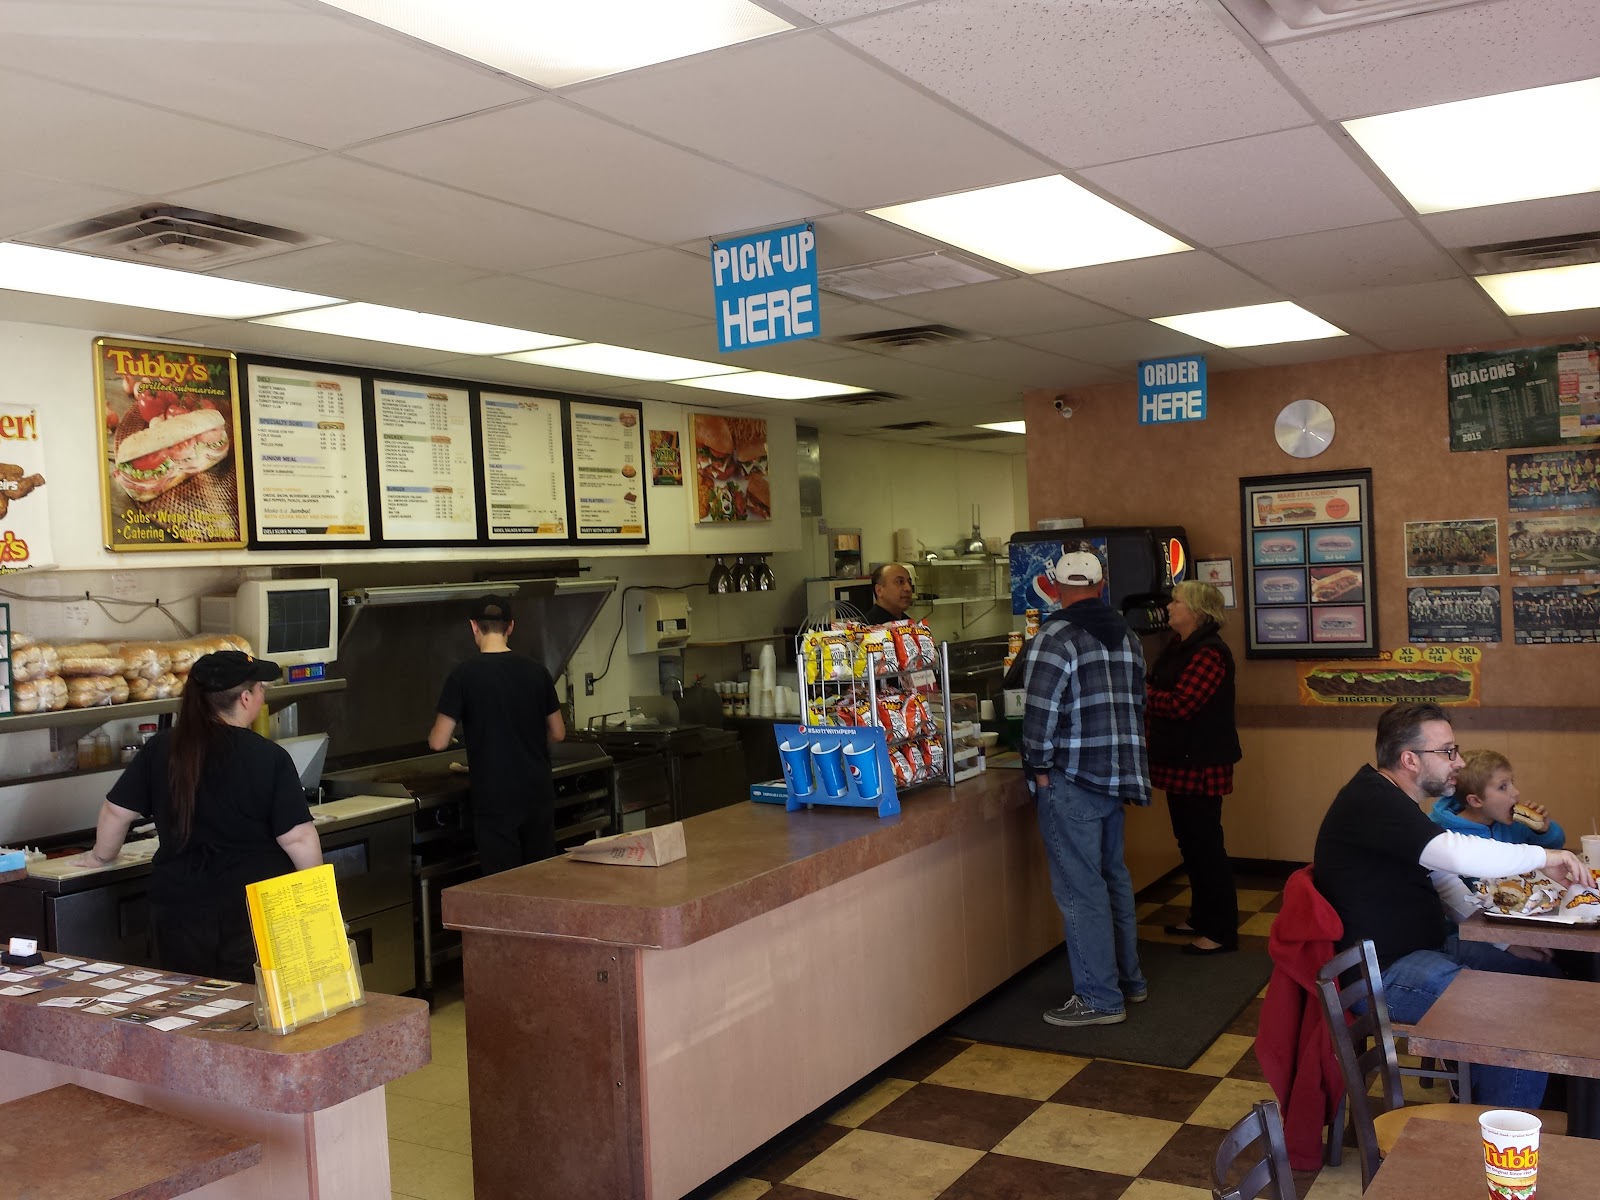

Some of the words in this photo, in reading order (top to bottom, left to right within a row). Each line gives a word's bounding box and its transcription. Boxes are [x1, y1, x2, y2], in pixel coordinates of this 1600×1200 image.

[714, 230, 815, 287] PICK-UP
[722, 284, 813, 347] HERE
[107, 349, 209, 383] Tubby's
[1144, 361, 1199, 387] ORDER
[1450, 363, 1516, 388] DRAGONS
[1142, 390, 1202, 422] HERE
[1461, 432, 1482, 442] 2015
[126, 509, 151, 524] Subs
[157, 509, 188, 525] Wraps
[123, 524, 165, 542] Catering
[1458, 647, 1478, 655] 3XL
